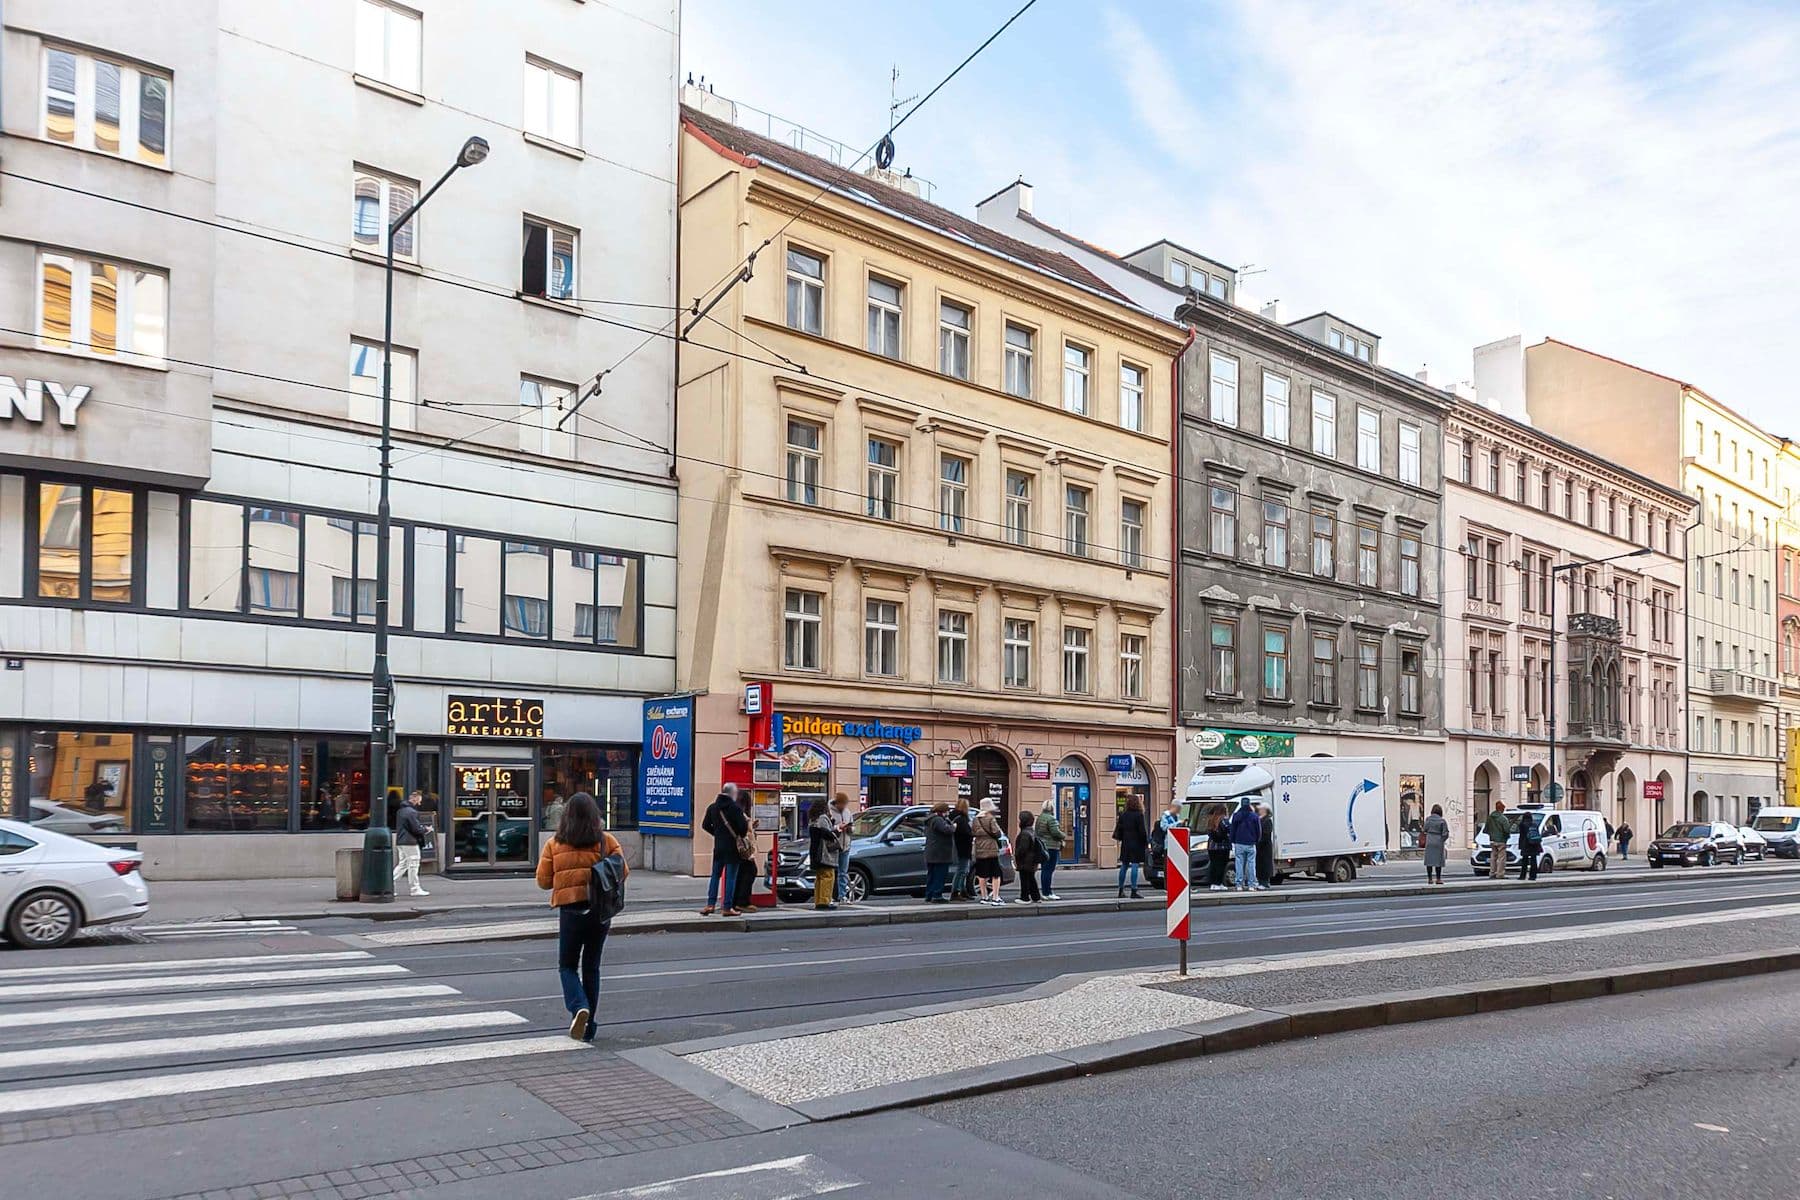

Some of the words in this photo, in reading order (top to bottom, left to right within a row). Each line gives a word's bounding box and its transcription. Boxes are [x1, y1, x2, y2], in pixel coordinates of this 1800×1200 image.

[448, 698, 543, 725] artic
[448, 725, 543, 737] BAKEHOUSE
[783, 716, 841, 735] Golden
[844, 719, 922, 745] exchange
[652, 725, 678, 760] 0%
[646, 765, 675, 777] SMĚNÁRNA
[1054, 767, 1081, 778] FOKUS
[646, 777, 674, 786] EXCHANGE
[153, 762, 165, 821] HARMONY
[646, 786, 685, 797] WECHSELSTUBE
